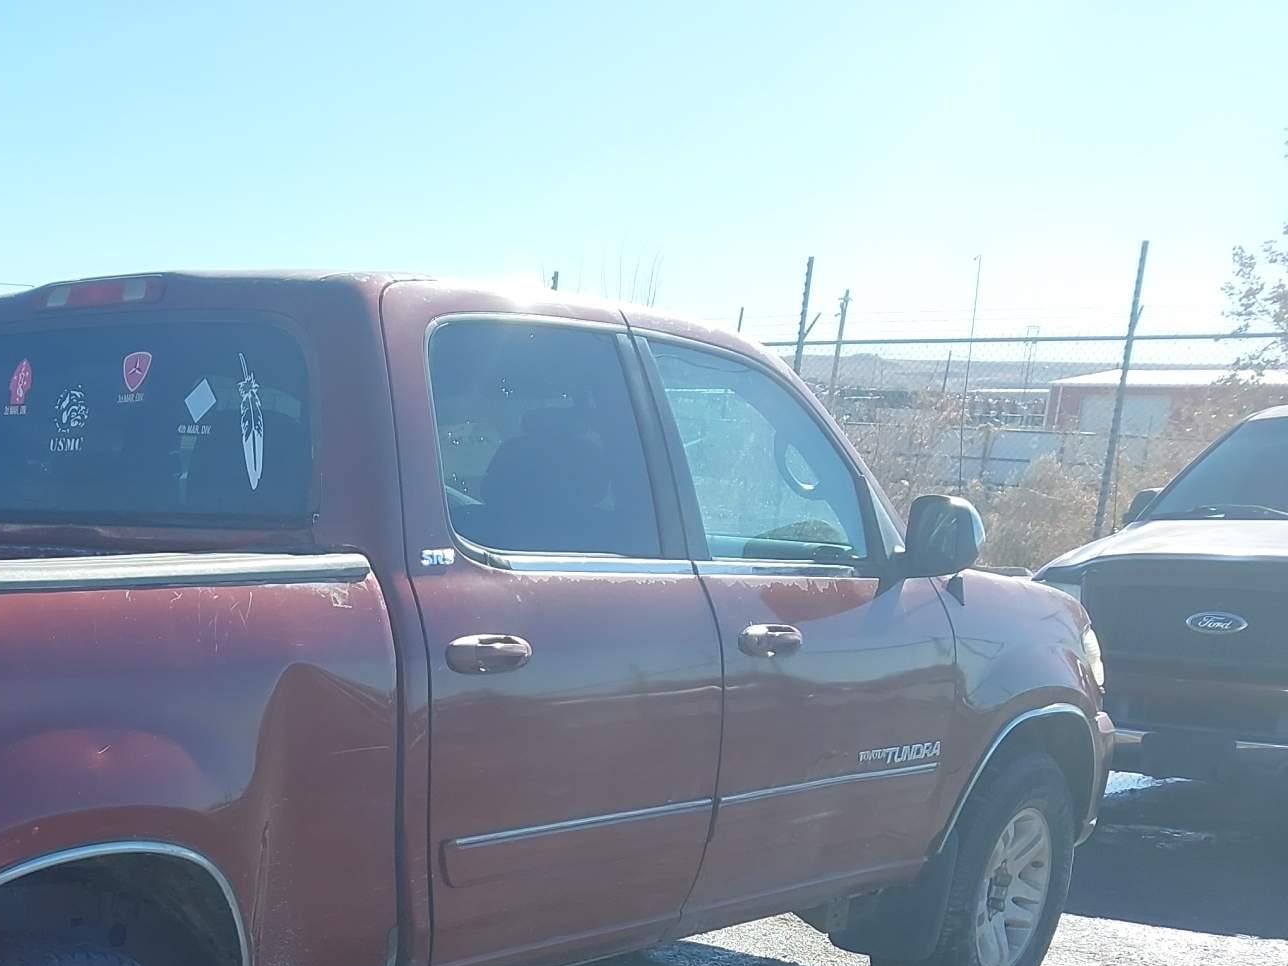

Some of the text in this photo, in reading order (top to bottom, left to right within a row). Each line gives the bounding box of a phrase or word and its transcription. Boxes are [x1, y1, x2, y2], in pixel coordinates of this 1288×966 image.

[49, 437, 84, 451] USMC
[421, 548, 455, 566] SR5
[1198, 615, 1233, 629] Ford
[886, 741, 941, 764] TUNDRA
